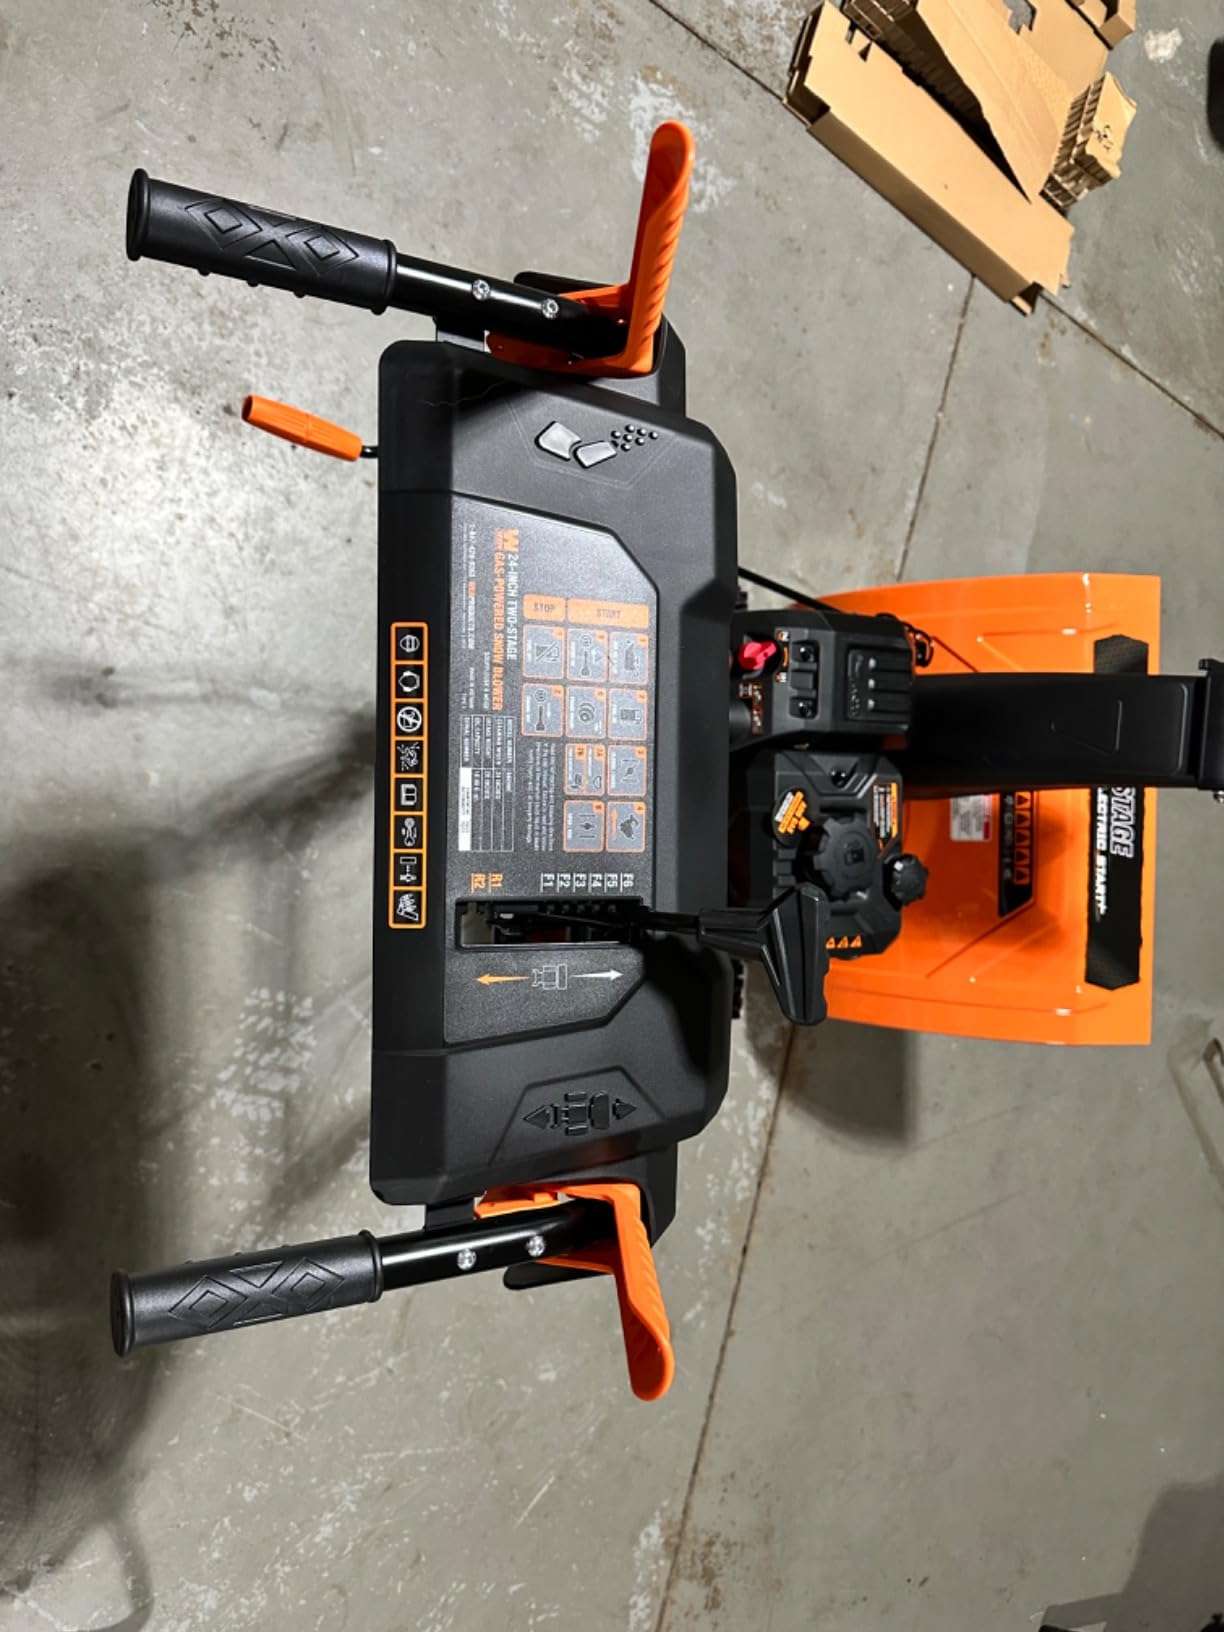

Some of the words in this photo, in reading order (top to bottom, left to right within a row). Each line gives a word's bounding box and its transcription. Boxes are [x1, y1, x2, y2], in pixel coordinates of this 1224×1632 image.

[507, 553, 519, 597] 24-INCH
[493, 552, 505, 631] GAS-POWERED
[506, 600, 518, 660] TWO-STAGE
[493, 633, 504, 664] SNOW
[492, 667, 504, 710] BLOWER
[474, 873, 485, 889] R2
[491, 873, 503, 888] R1
[543, 873, 555, 888] F1
[559, 873, 570, 888] F2
[576, 873, 586, 888] F3
[591, 873, 602, 888] F4
[607, 873, 617, 888] F5
[623, 873, 634, 888] F6
